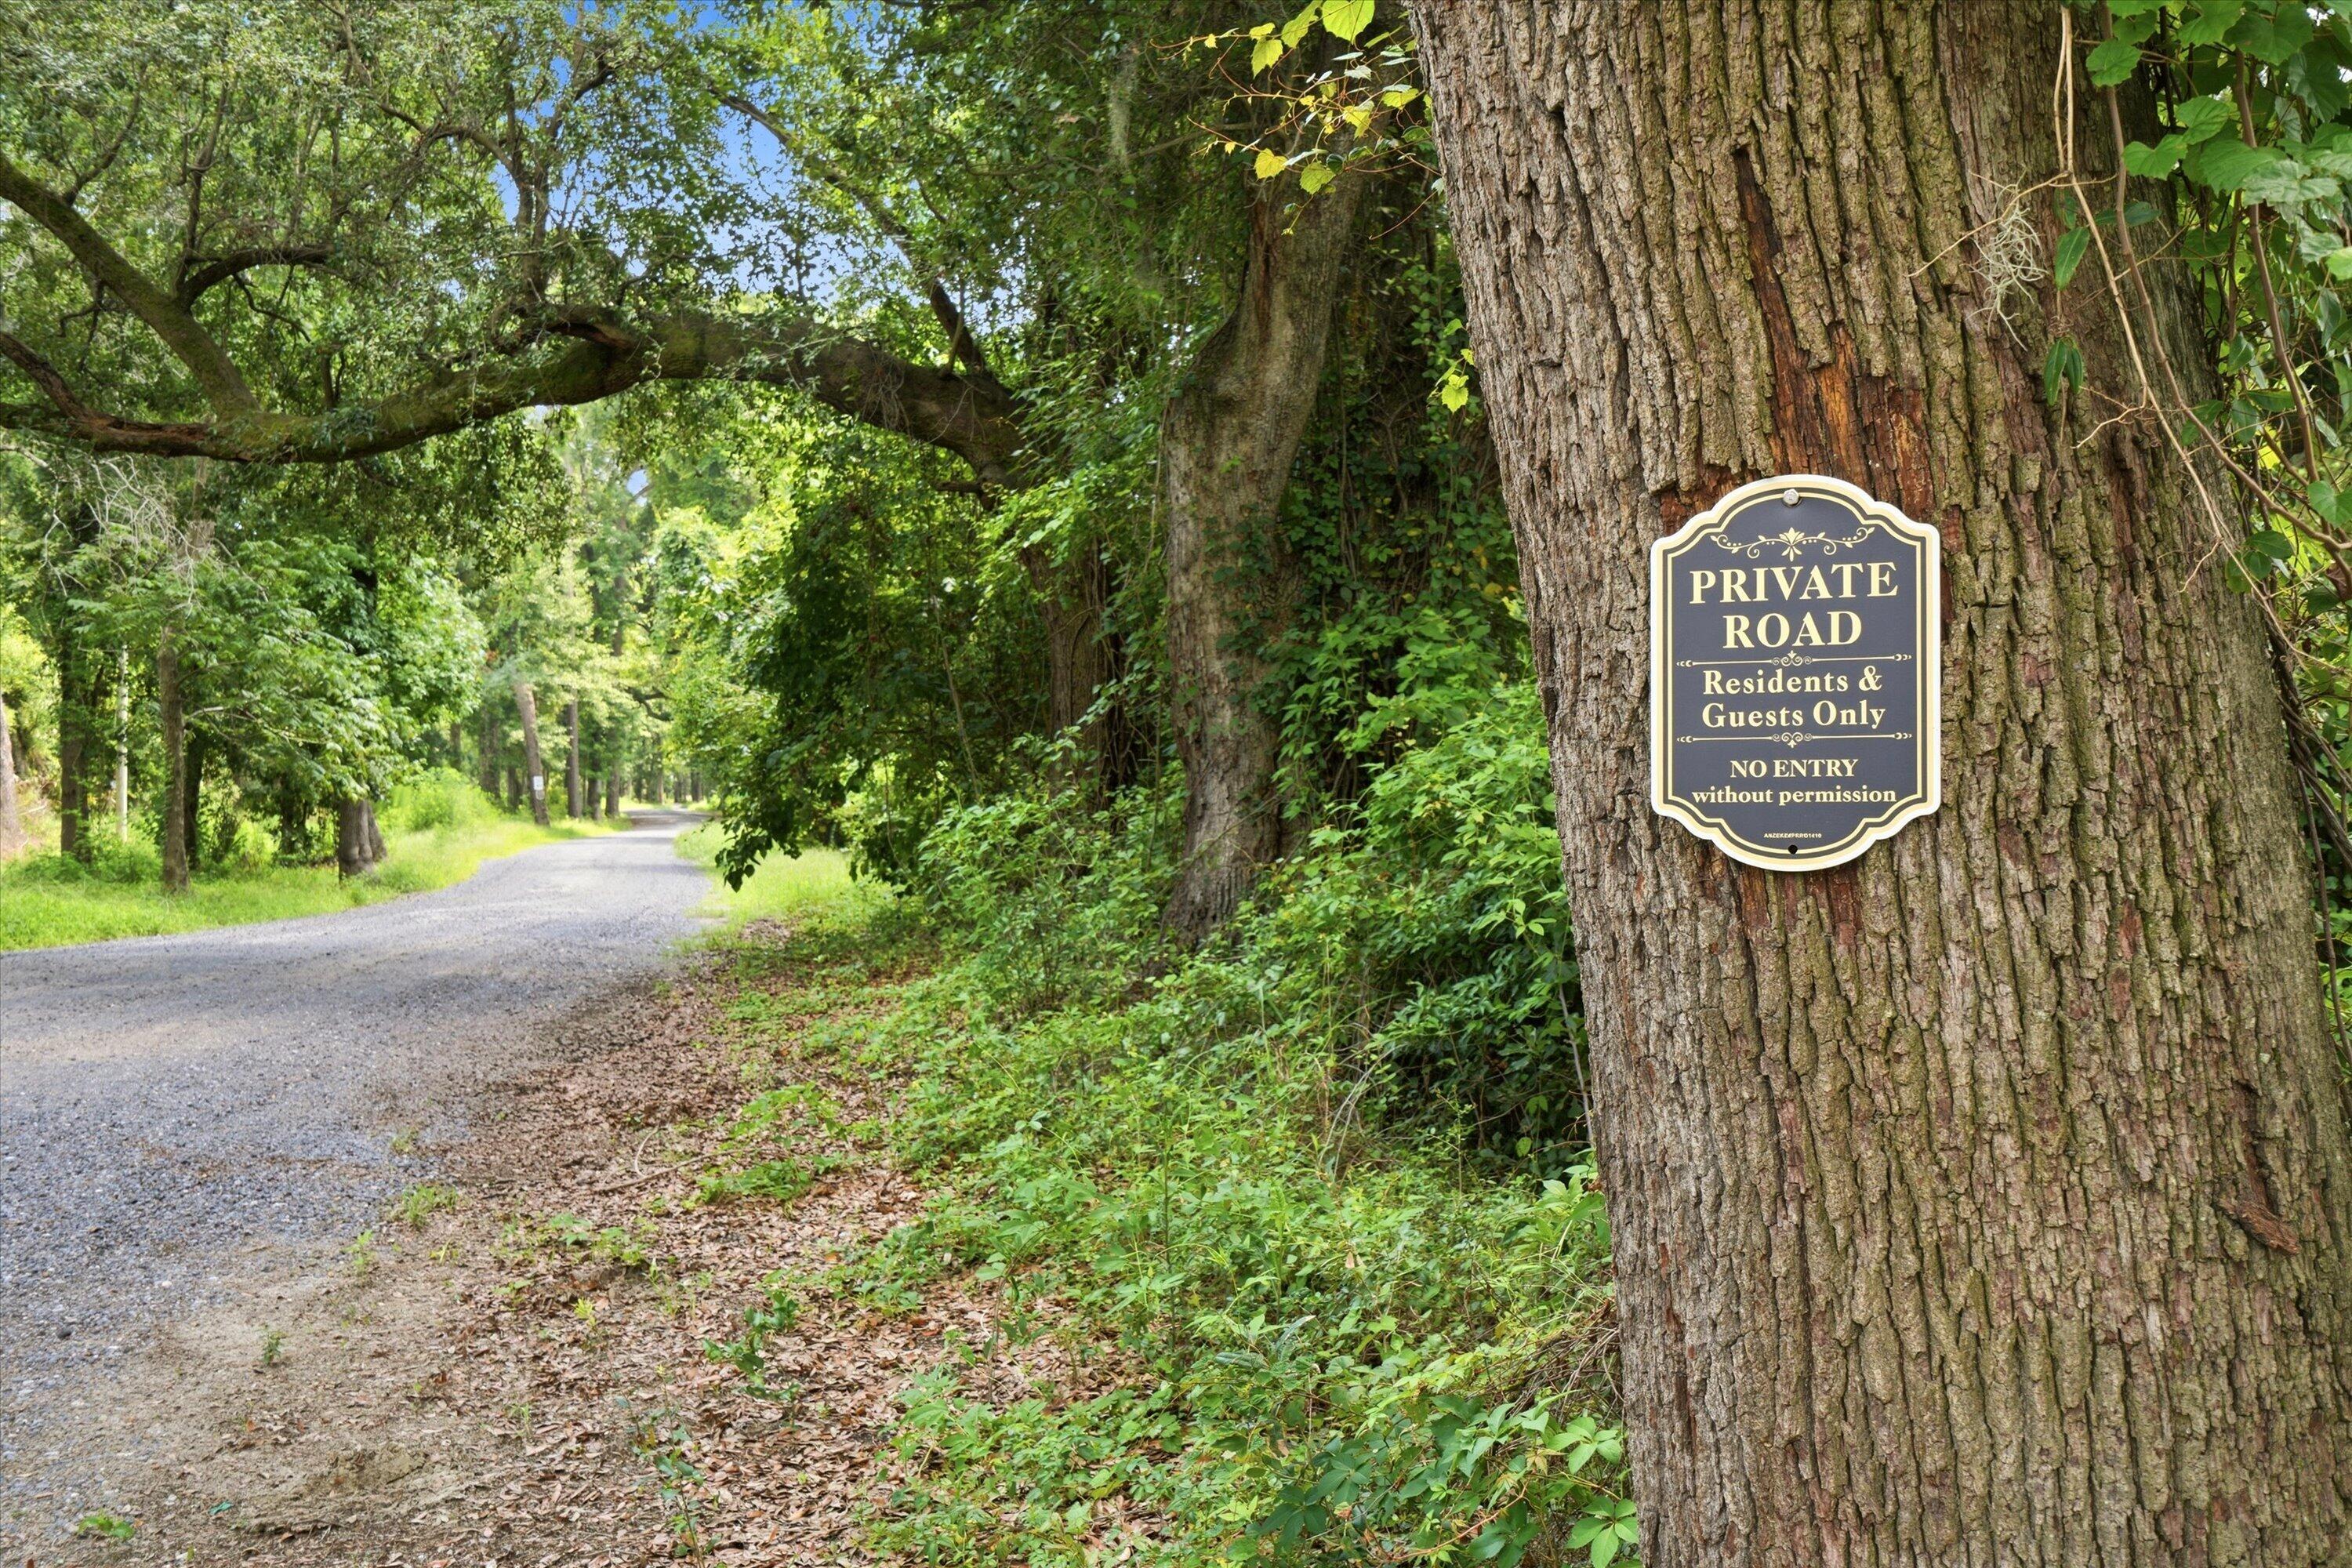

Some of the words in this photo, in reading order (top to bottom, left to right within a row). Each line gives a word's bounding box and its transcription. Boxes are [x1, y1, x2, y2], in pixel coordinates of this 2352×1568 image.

[1690, 562, 1898, 604] PRIVATE
[1722, 611, 1862, 648] ROAD
[1703, 670, 1848, 695] Residents
[1858, 665, 1882, 691] &
[1702, 703, 1803, 728] Guests
[1813, 699, 1886, 729] Only
[1730, 760, 1766, 779] NO
[1773, 759, 1859, 778] ENTRY
[1692, 786, 1773, 804] without
[1779, 785, 1897, 807] permission
